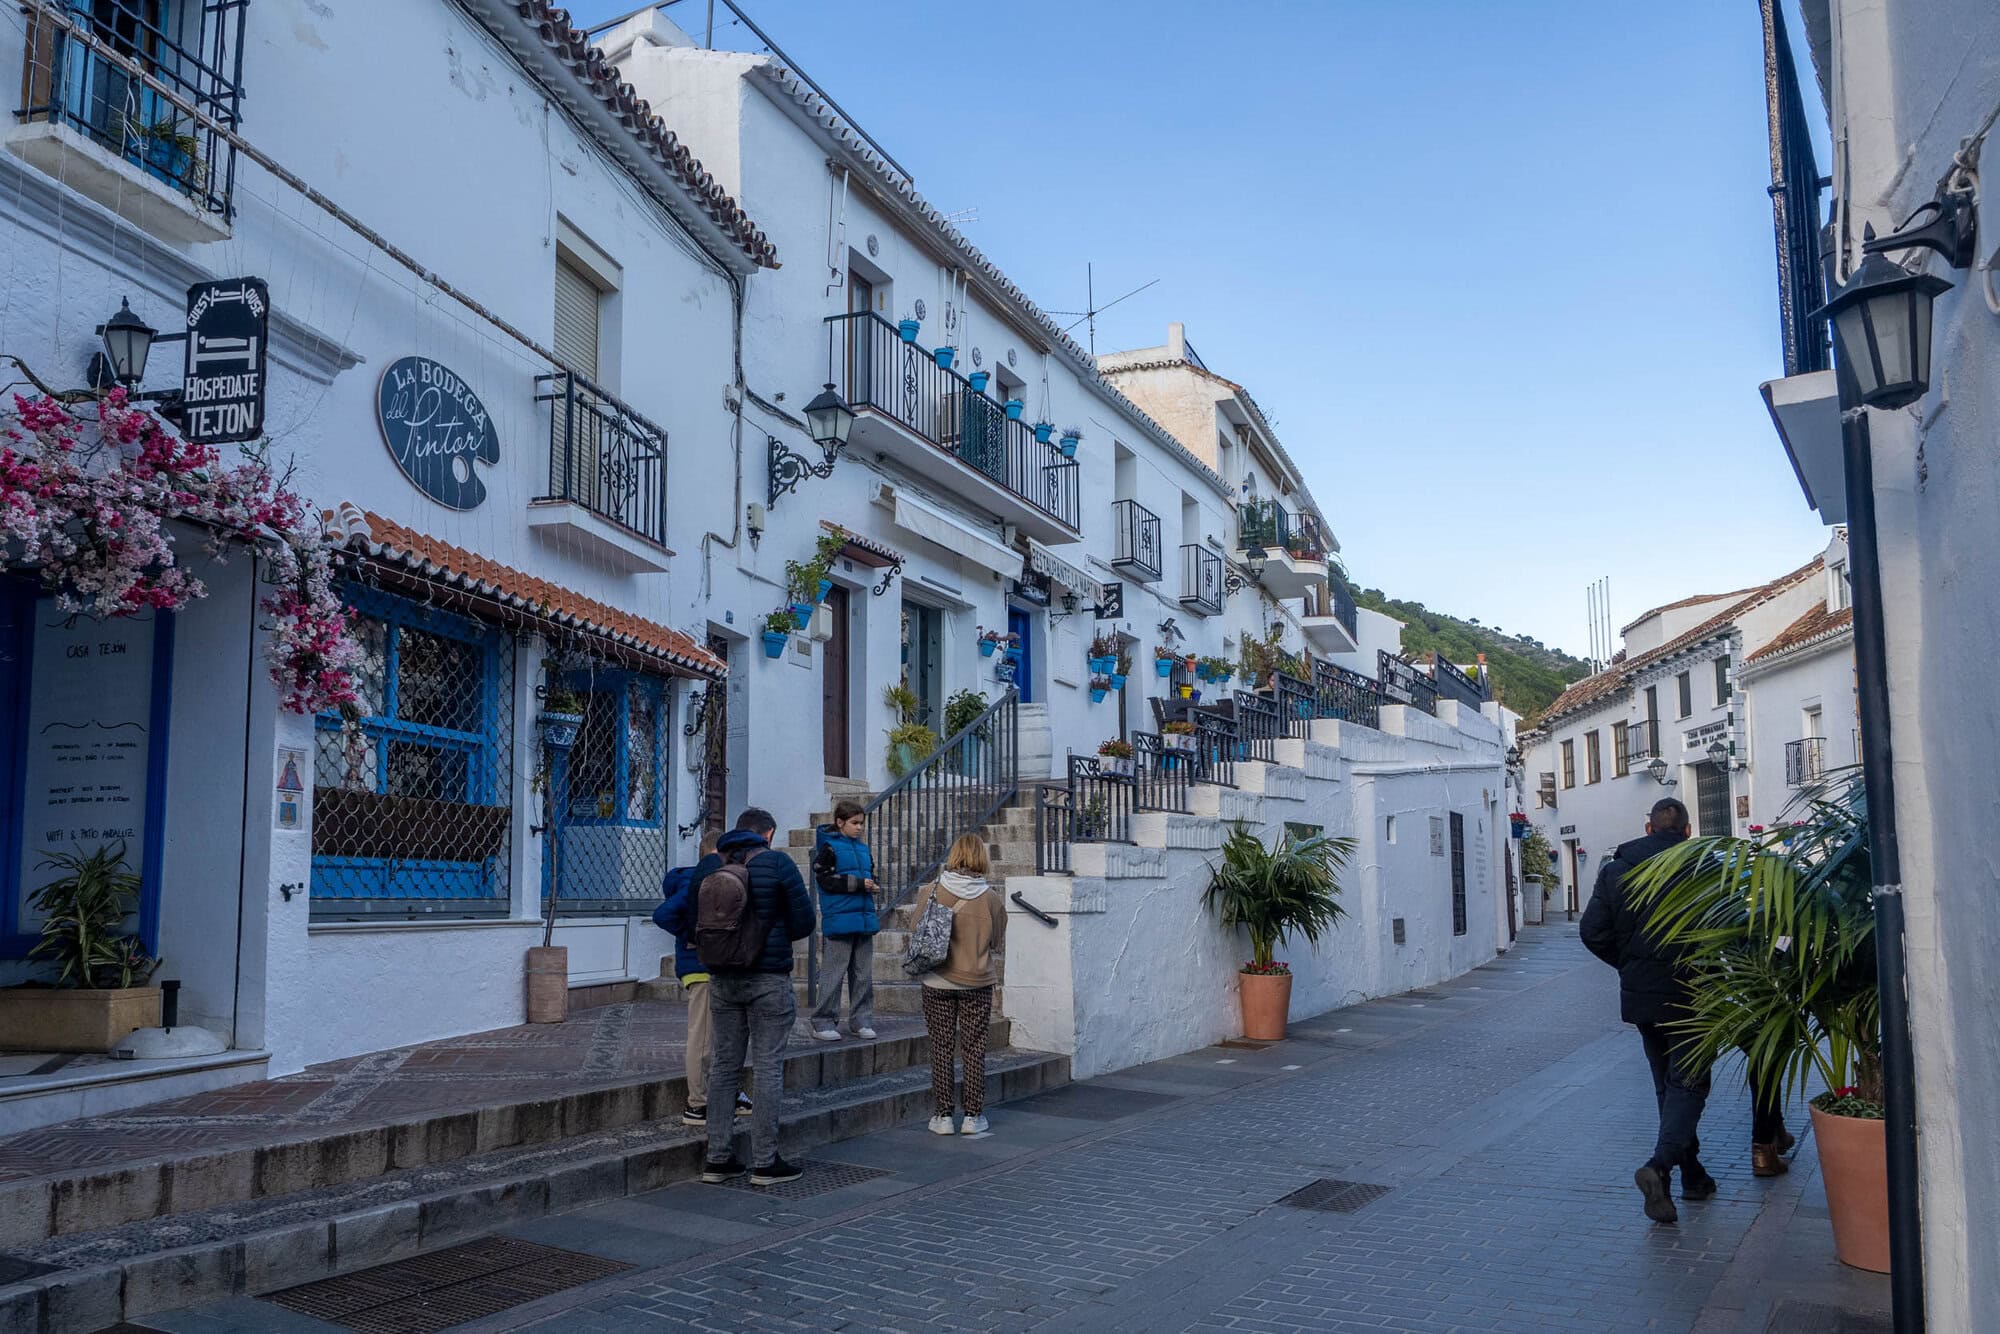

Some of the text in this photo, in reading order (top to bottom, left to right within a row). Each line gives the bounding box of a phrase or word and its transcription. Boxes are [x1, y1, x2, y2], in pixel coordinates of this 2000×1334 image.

[187, 291, 211, 327] GUEST
[184, 373, 258, 402] HOSPEDAJE
[392, 361, 487, 434] LA BODEGA
[187, 402, 255, 437] TEJON
[386, 391, 409, 420] del
[401, 387, 485, 464] Pintor
[66, 644, 89, 658] CASA
